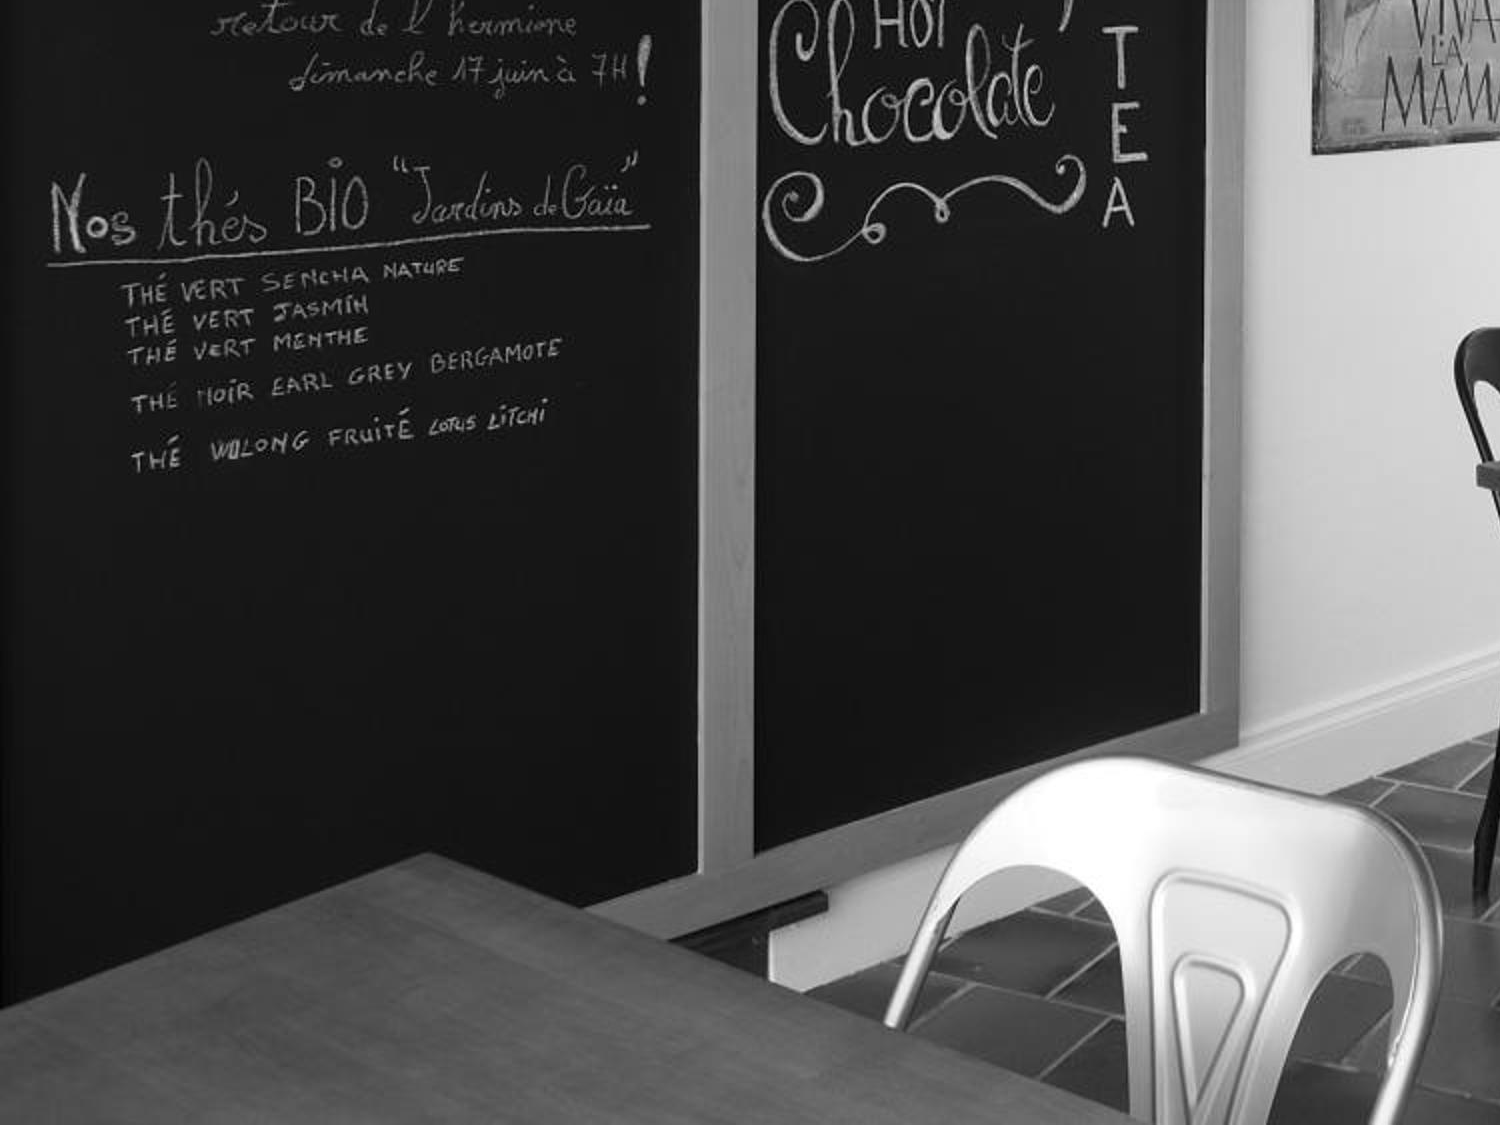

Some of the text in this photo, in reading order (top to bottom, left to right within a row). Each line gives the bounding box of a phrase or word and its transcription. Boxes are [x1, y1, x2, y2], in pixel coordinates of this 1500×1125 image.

[452, 53, 484, 87] 17
[489, 58, 550, 101] juin
[1100, 24, 1149, 228] TEA
[50, 171, 138, 254] Nos
[156, 156, 268, 252] thés
[119, 256, 465, 308] THÉ VERT SENCHA NATURE
[124, 307, 176, 339] THÉ
[192, 308, 256, 331] VERT
[126, 326, 370, 367] THÉ VERT MENTHE
[271, 371, 334, 398] EARL
[346, 361, 413, 387] GREY
[429, 336, 564, 375] BERGAMOTE
[130, 434, 181, 474] THÉ
[427, 412, 478, 437] LOTUS
